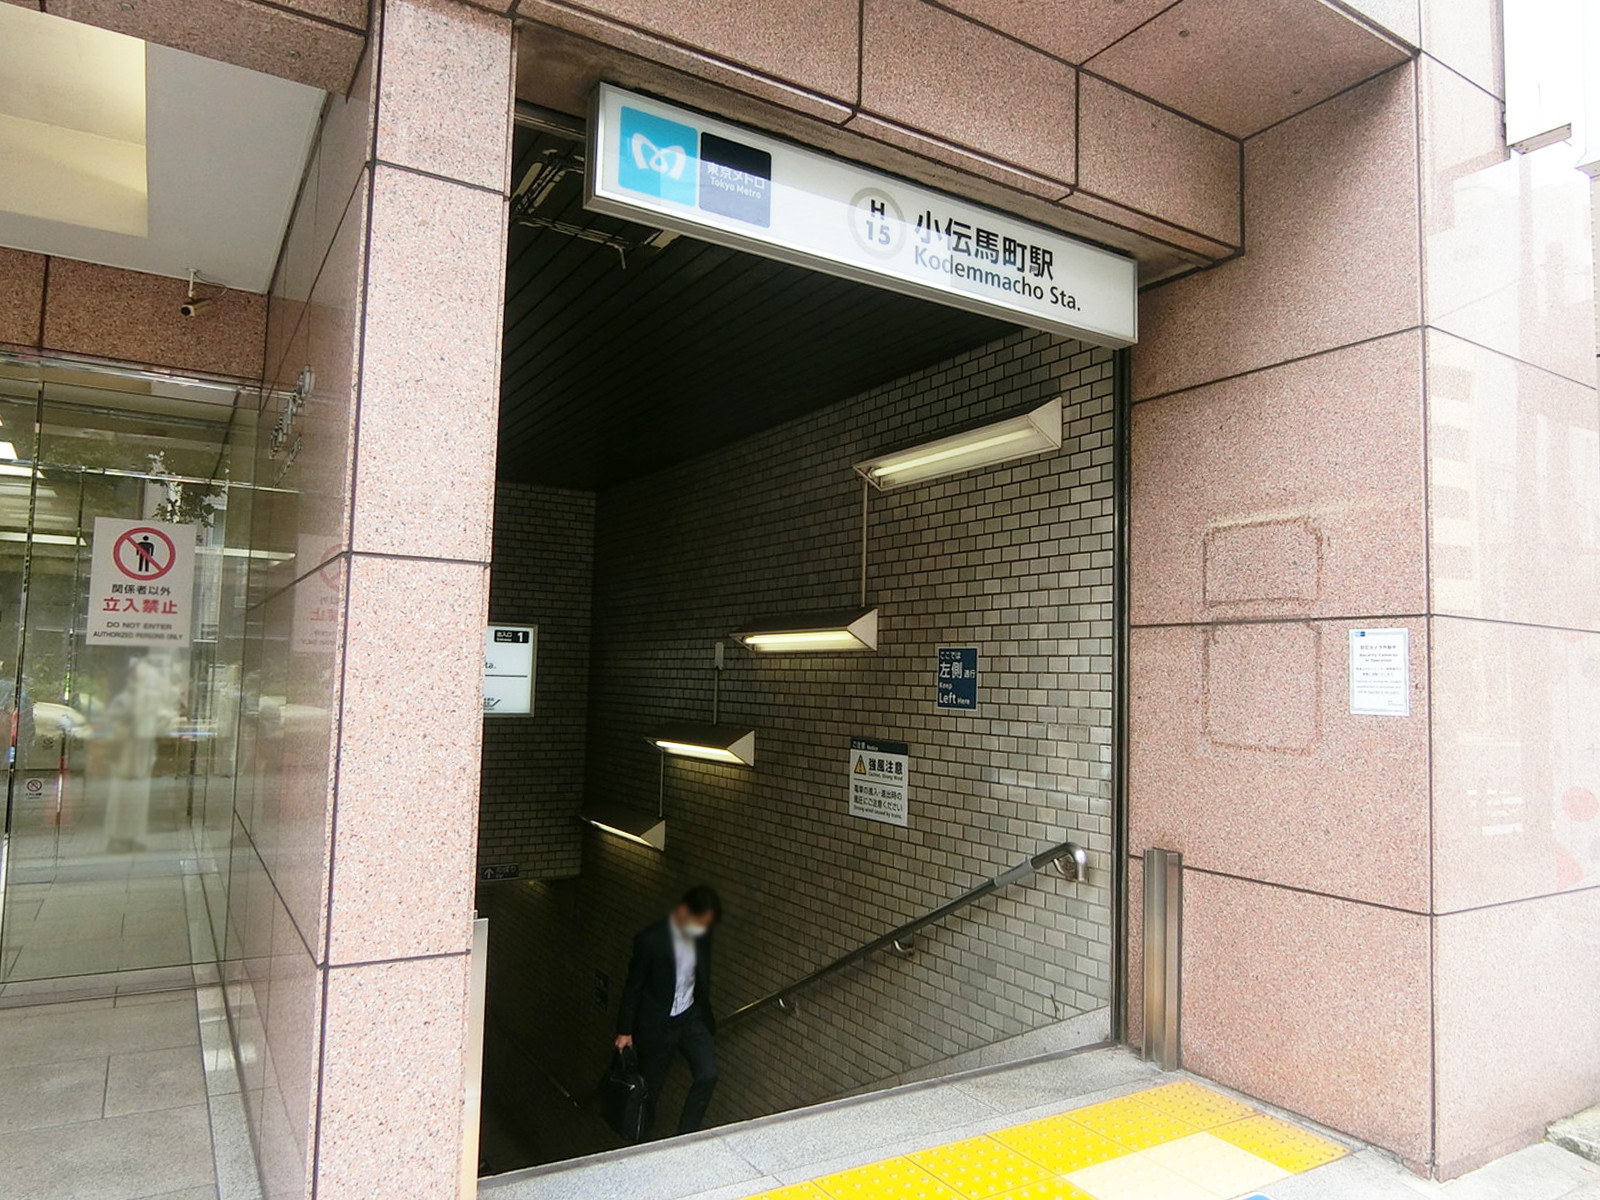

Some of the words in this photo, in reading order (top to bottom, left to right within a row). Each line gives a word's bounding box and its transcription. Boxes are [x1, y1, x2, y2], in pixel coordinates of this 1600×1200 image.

[706, 162, 765, 190] 東京メトロ
[710, 176, 736, 192] Tokyo
[736, 184, 762, 199] Metro
[869, 199, 886, 220] H
[865, 219, 891, 247] 15
[913, 209, 1055, 281] 小伝馬町駅
[914, 245, 1044, 300] Kodemmacho
[1049, 285, 1081, 311] Sta.
[111, 583, 171, 596] 関係者以外
[102, 597, 179, 615] 立入禁止
[166, 633, 183, 641] ONLY
[518, 632, 524, 642] 1
[940, 651, 961, 660] ここでは
[939, 681, 953, 690] Keep
[939, 691, 956, 704] Left
[868, 757, 903, 775] 強風注意
